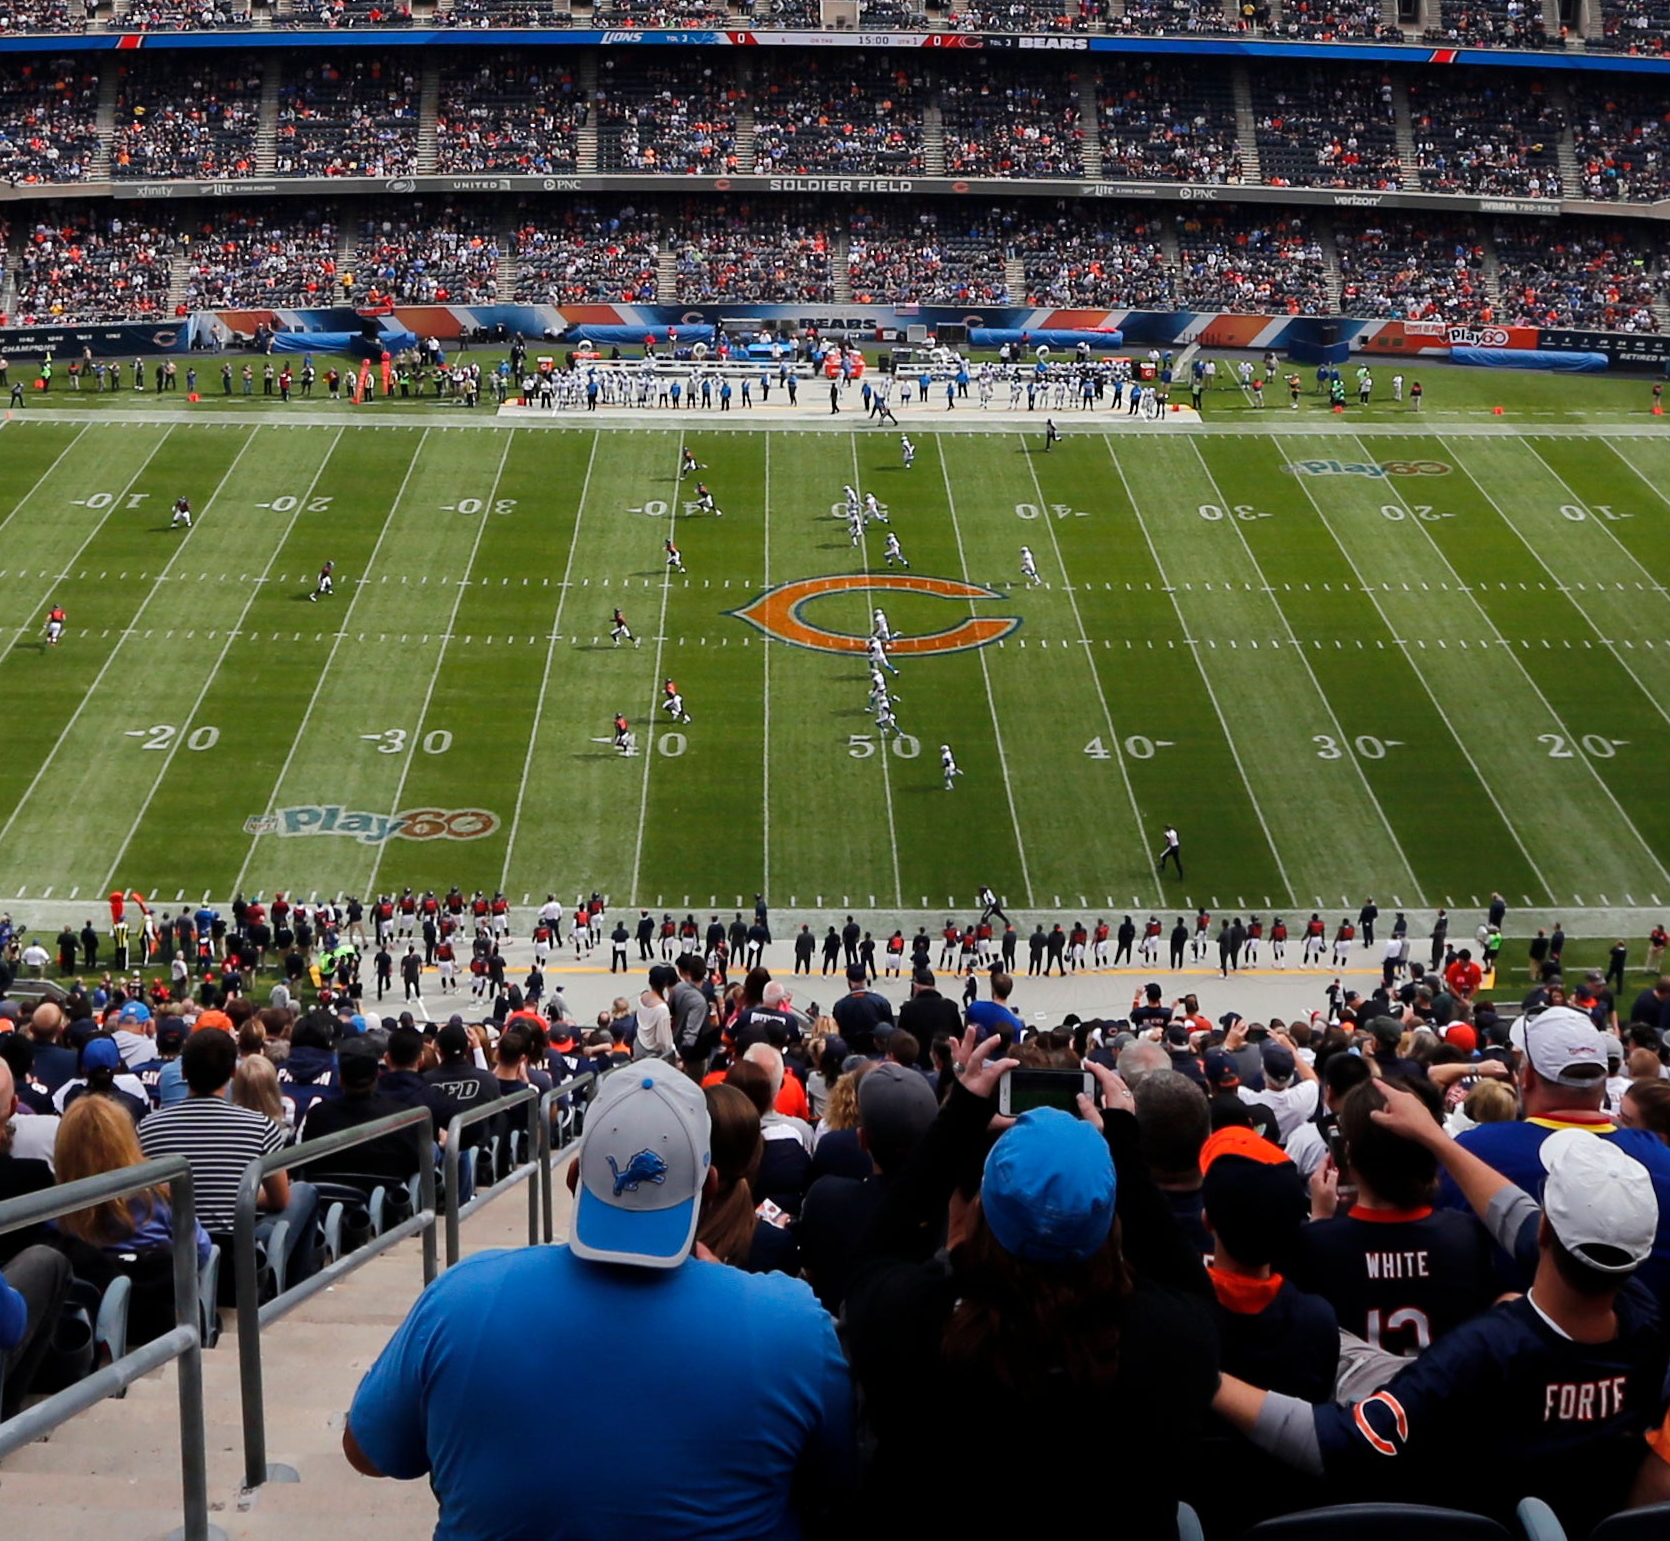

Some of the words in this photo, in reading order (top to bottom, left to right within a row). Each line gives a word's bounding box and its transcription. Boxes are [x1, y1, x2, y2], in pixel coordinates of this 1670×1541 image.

[599, 32, 644, 44] LIONS
[737, 33, 745, 44] 0
[858, 36, 889, 45] 15:00
[933, 36, 941, 46] 0
[1018, 38, 1088, 49] BEARS
[137, 184, 173, 197] xfinity
[453, 181, 498, 190] UNITED
[557, 180, 582, 190] PNC
[770, 180, 852, 192] SOLDIER
[858, 180, 912, 192] FIELD
[1193, 188, 1217, 198] PNC
[1334, 196, 1378, 207] verizon
[1481, 201, 1516, 212] WBBM
[799, 318, 877, 330] BEARS
[1, 344, 57, 353] CHAMPIONS
[1619, 353, 1658, 362] RETIRED
[141, 725, 221, 752] 20
[376, 728, 454, 756] 30
[847, 733, 923, 760] 50
[1083, 734, 1157, 760] 40
[1312, 734, 1388, 760] 30
[1537, 733, 1618, 759] 20
[140, 1070, 161, 1085] SAY
[432, 1079, 480, 1100] FD
[1365, 1251, 1430, 1279] WHITE
[1543, 1376, 1626, 1423] FORTE
